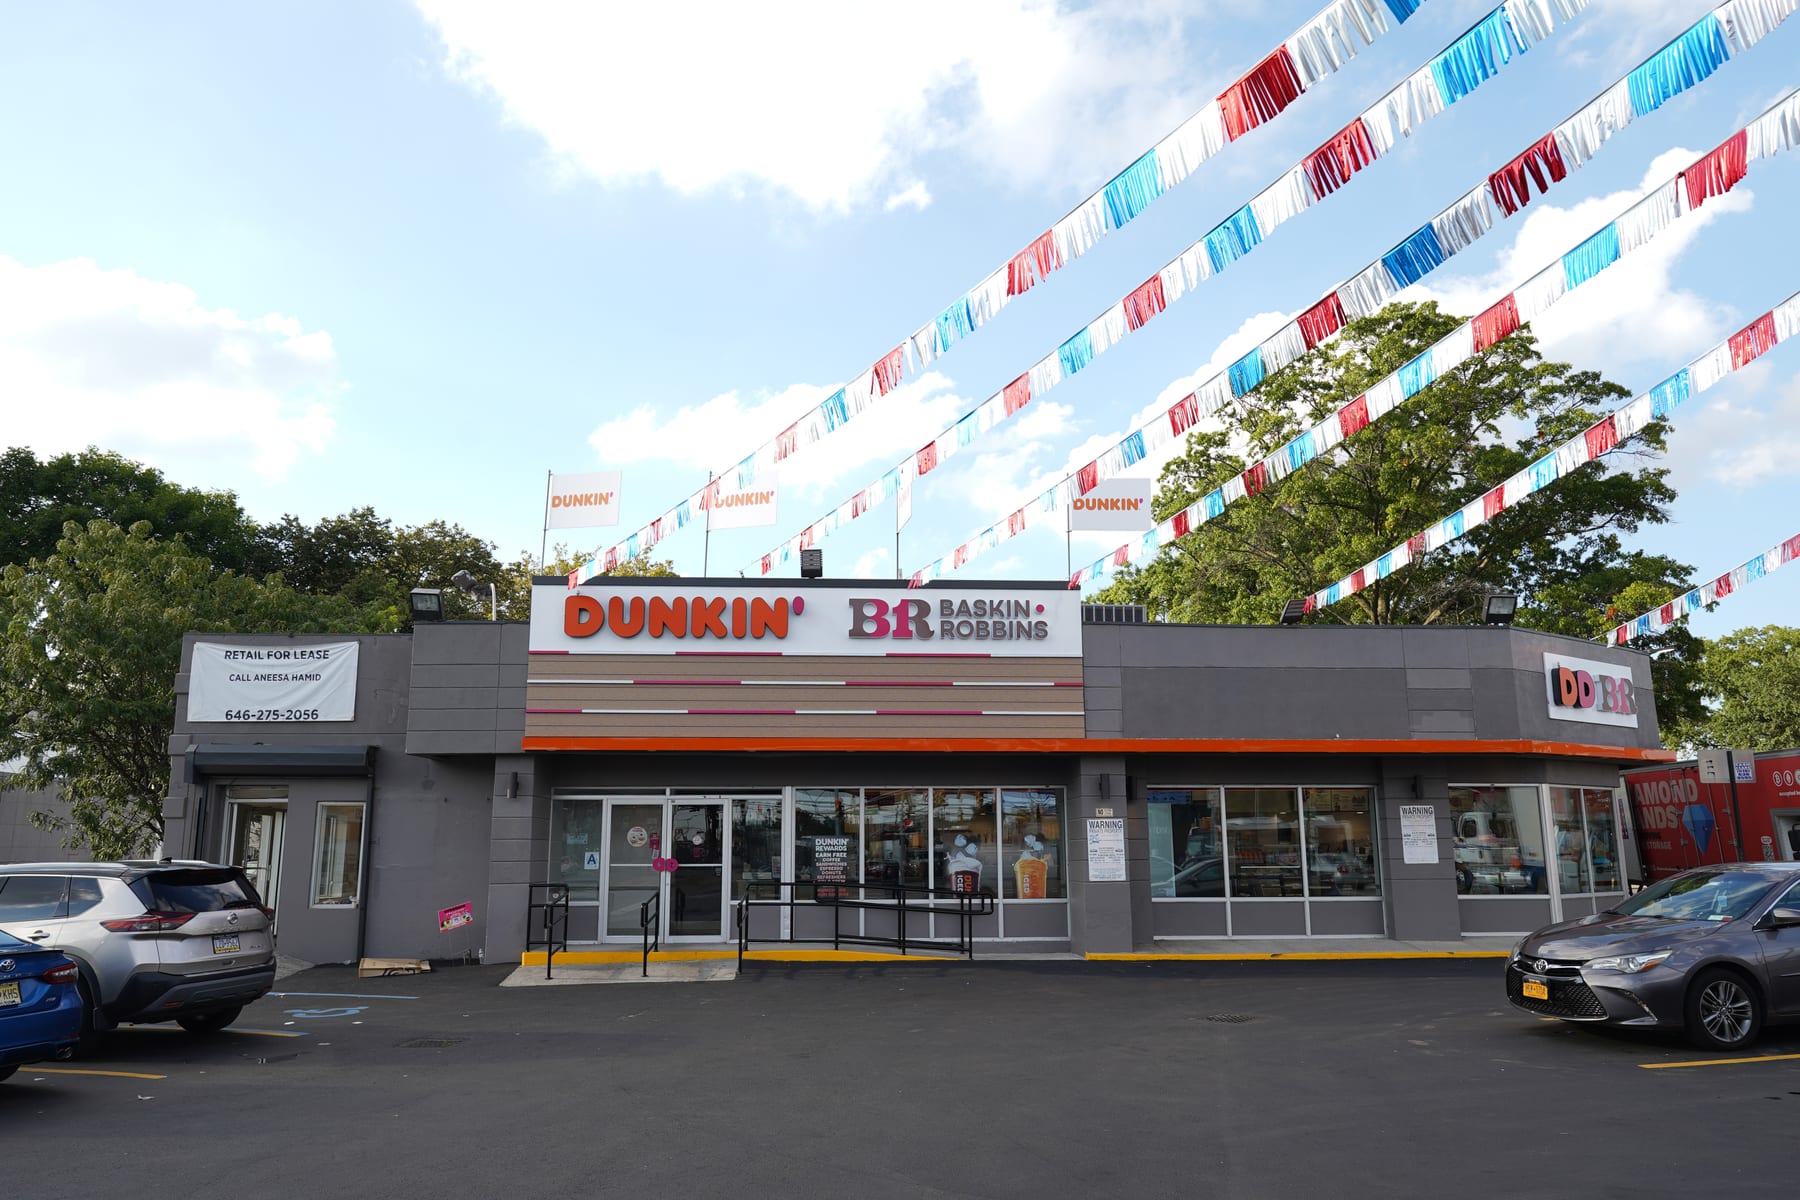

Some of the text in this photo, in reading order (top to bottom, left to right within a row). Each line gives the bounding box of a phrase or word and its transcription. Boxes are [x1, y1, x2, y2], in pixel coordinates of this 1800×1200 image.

[551, 491, 613, 508] DUNKIN'
[1073, 497, 1144, 511] DUNKIN'
[563, 595, 805, 639] DUNKIN'
[939, 599, 1031, 618] BASKIN
[848, 598, 935, 640] BR
[939, 619, 1049, 640] ROBBINS
[224, 649, 330, 660] RETAIL FOR LEASE
[229, 673, 322, 682] CALL ANEESA HAMID
[1551, 667, 1596, 709] DD
[1597, 674, 1638, 715] BR
[225, 709, 319, 720] 646-275-2056
[1401, 807, 1433, 815] WARNING
[1638, 805, 1679, 830] NDS
[815, 838, 849, 846] DUNKIN'
[587, 854, 596, 865] A
